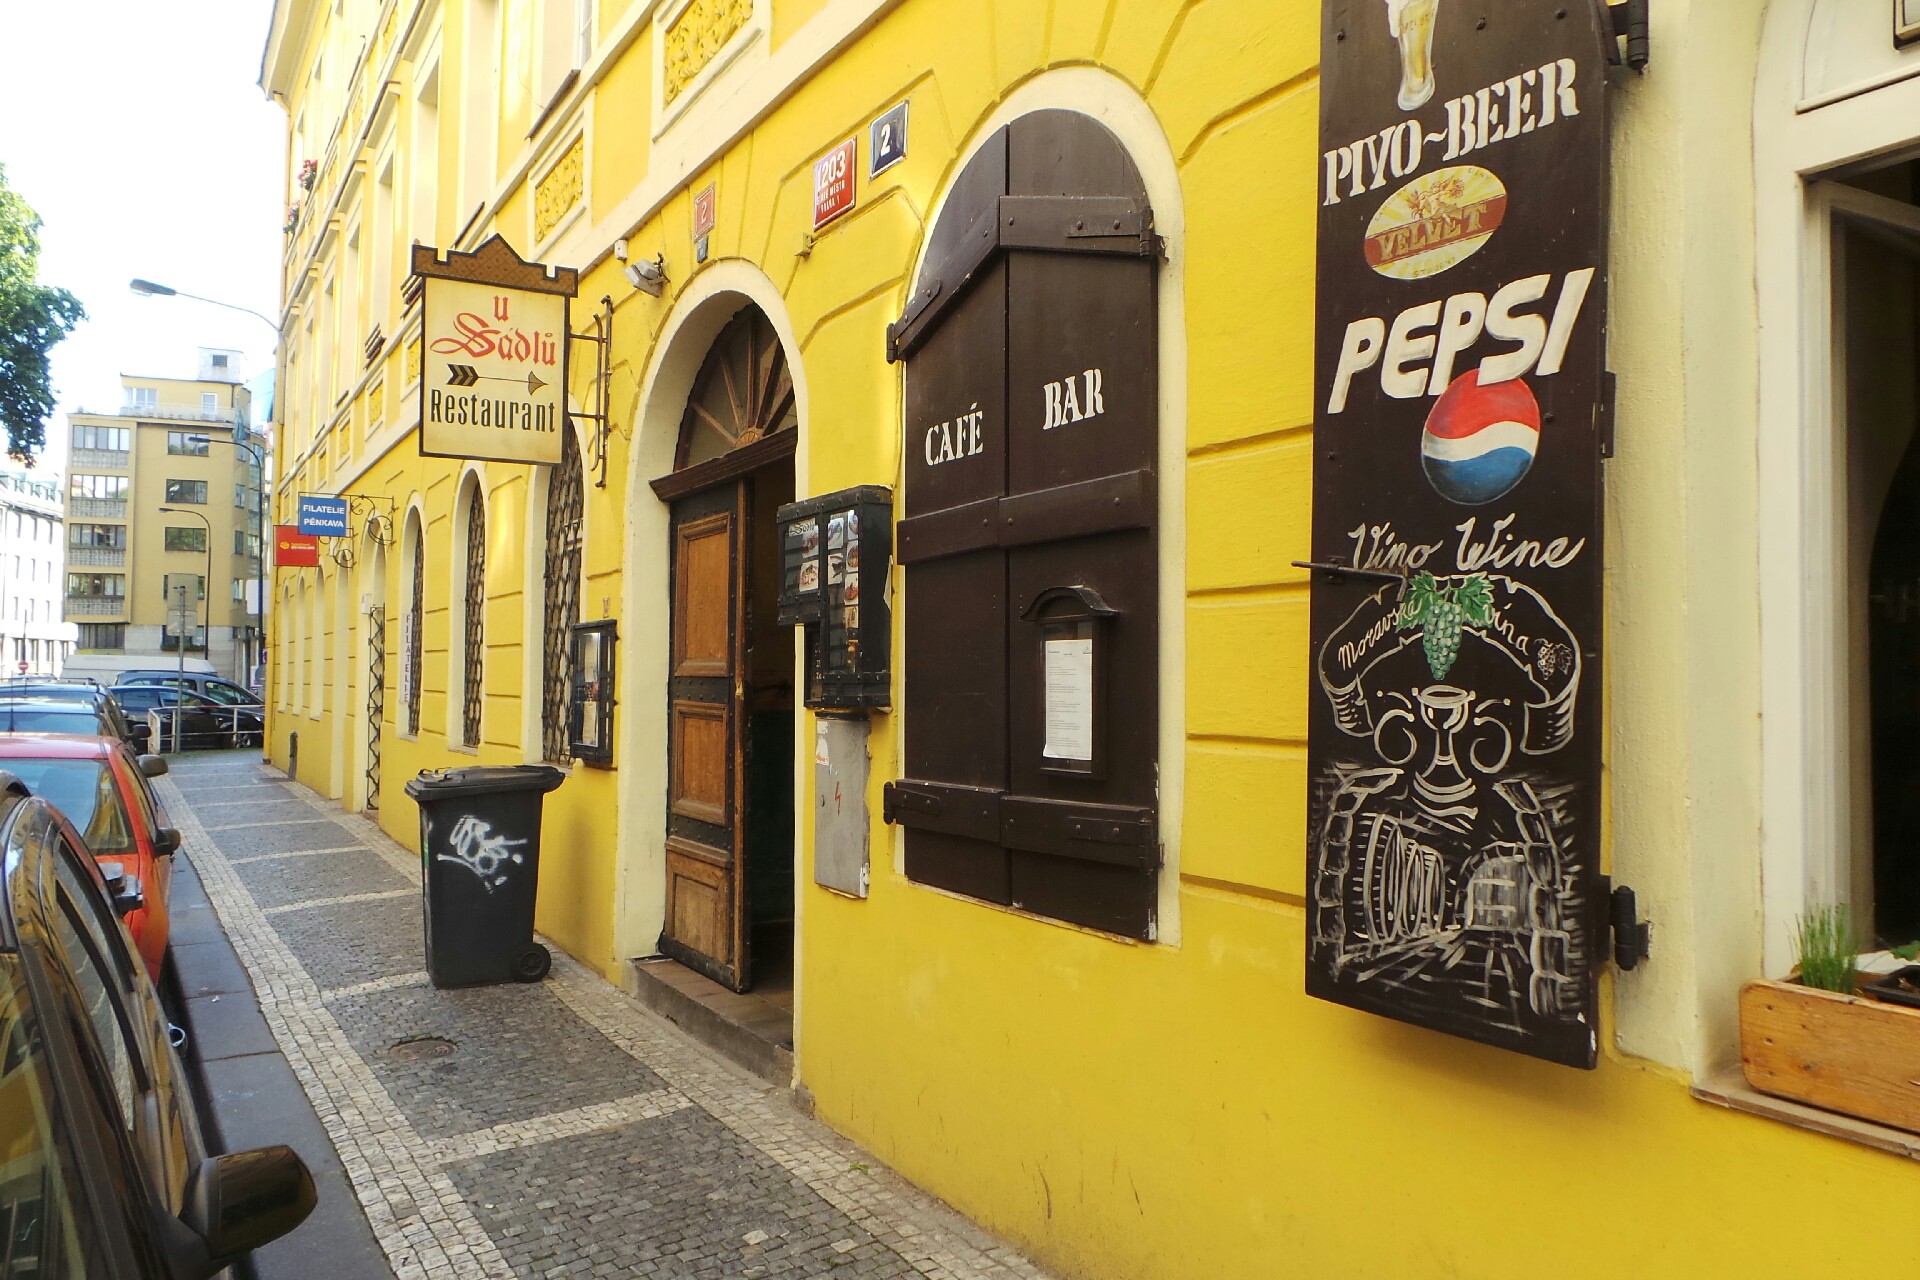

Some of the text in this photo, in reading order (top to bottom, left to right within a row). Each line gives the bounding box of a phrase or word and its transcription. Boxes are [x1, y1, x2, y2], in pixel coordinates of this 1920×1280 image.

[881, 123, 891, 157] 2
[701, 202, 707, 225] 2
[1376, 203, 1488, 260] VELVET
[1328, 267, 1595, 414] PEPSI
[431, 389, 555, 433] Restaurant
[1043, 368, 1105, 430] BAR
[925, 402, 984, 466] CAFÉ
[303, 504, 345, 514] FILATELIE
[1455, 513, 1586, 571] Wine
